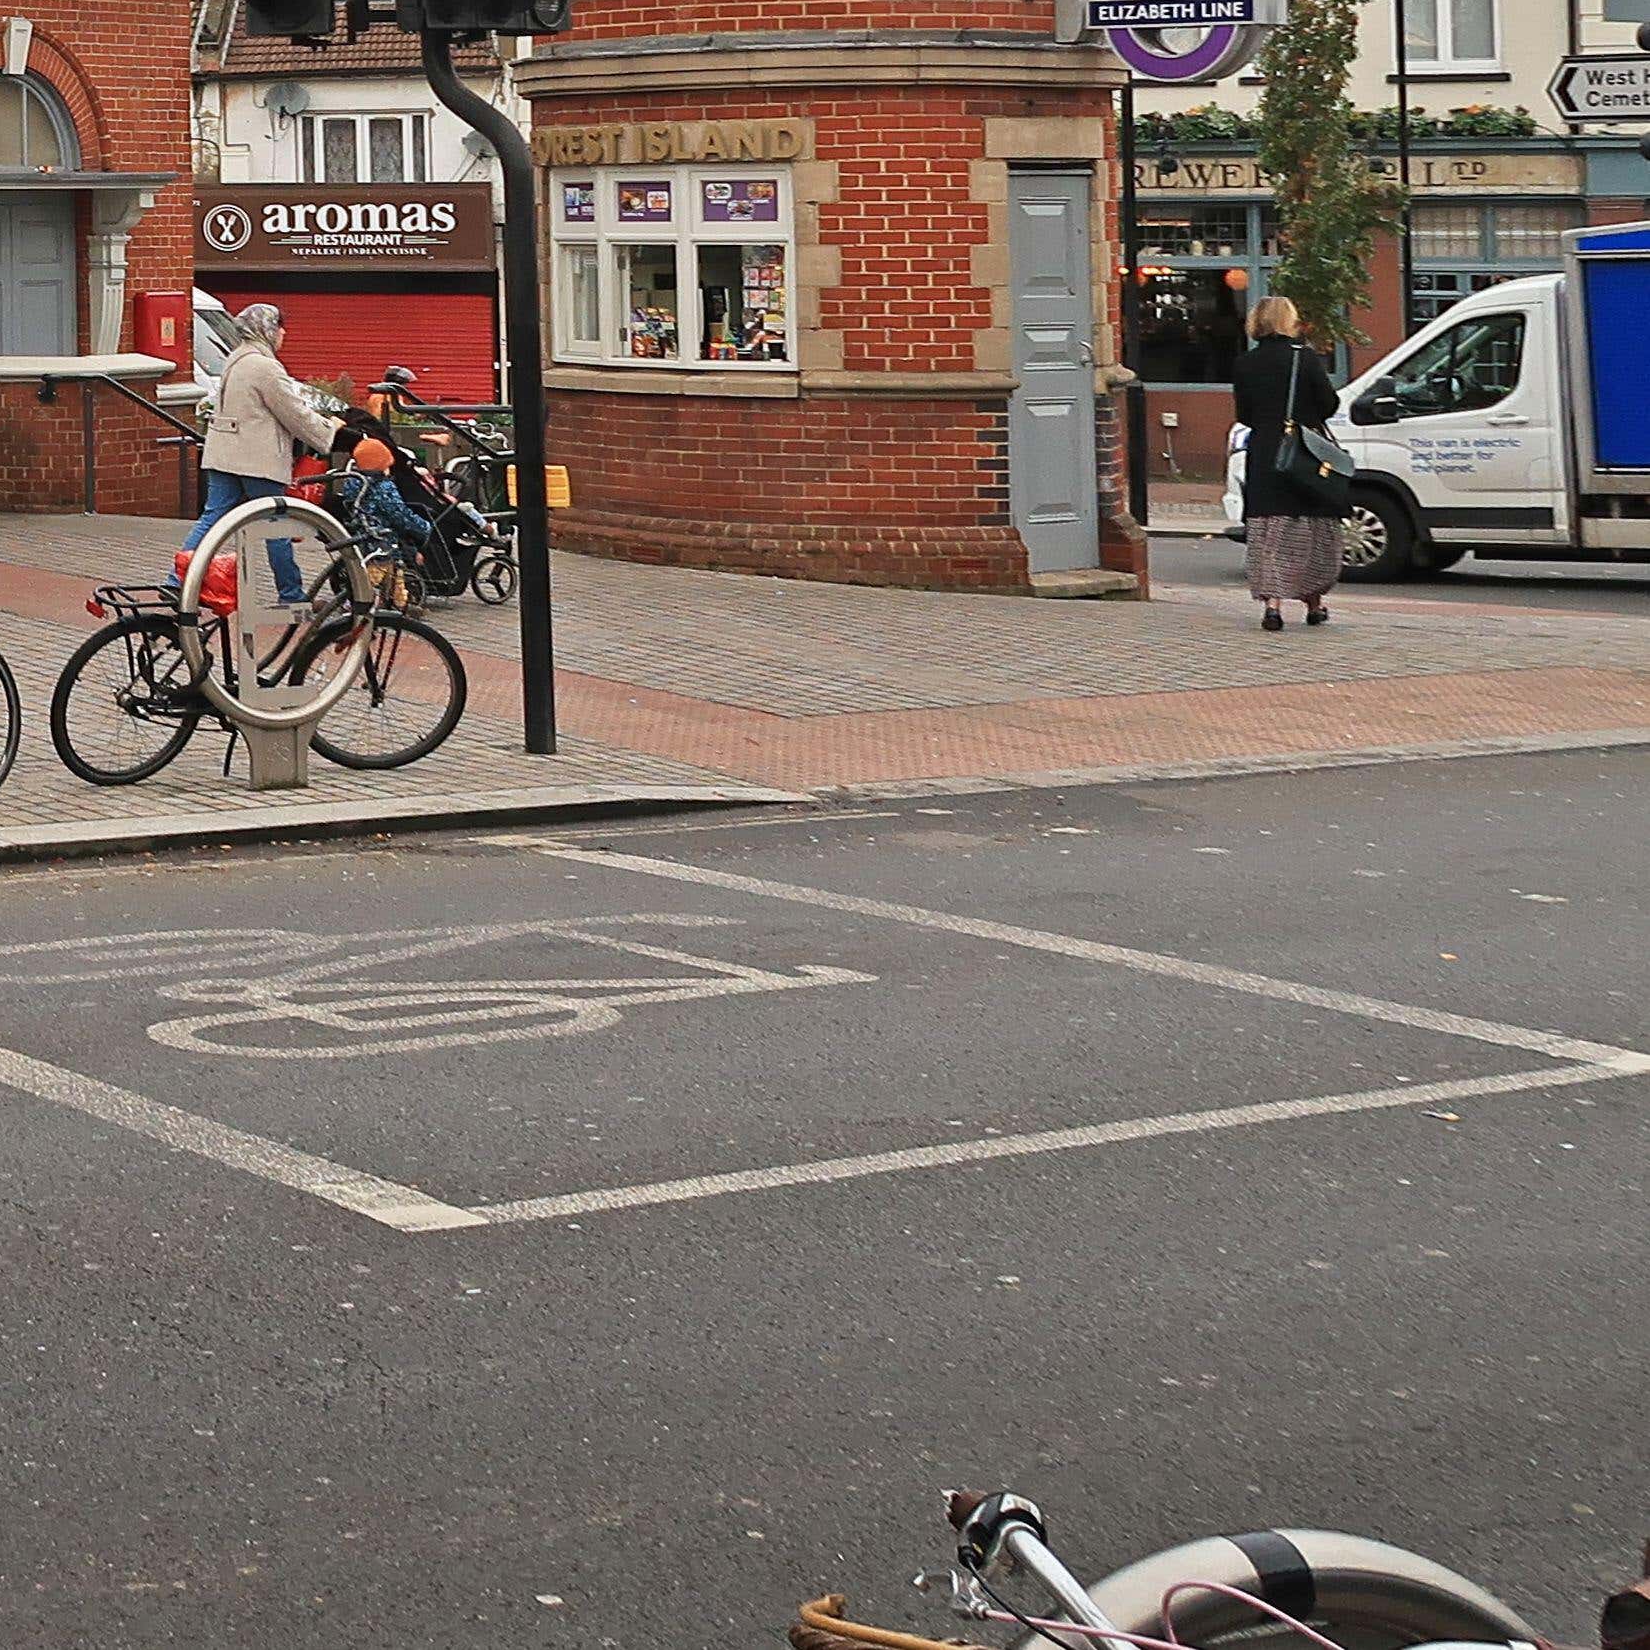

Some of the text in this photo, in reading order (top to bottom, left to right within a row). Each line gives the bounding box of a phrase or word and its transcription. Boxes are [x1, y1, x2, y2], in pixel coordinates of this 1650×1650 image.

[1098, 1, 1245, 21] ELIZABETH LINE
[1586, 69, 1636, 85] West
[633, 123, 803, 163] ISLAND
[262, 202, 457, 233] aromas
[314, 234, 403, 246] RESTAURANT
[1409, 438, 1433, 447] This
[1461, 438, 1471, 447] is
[1473, 438, 1521, 447] electric
[1411, 451, 1495, 461] and better for
